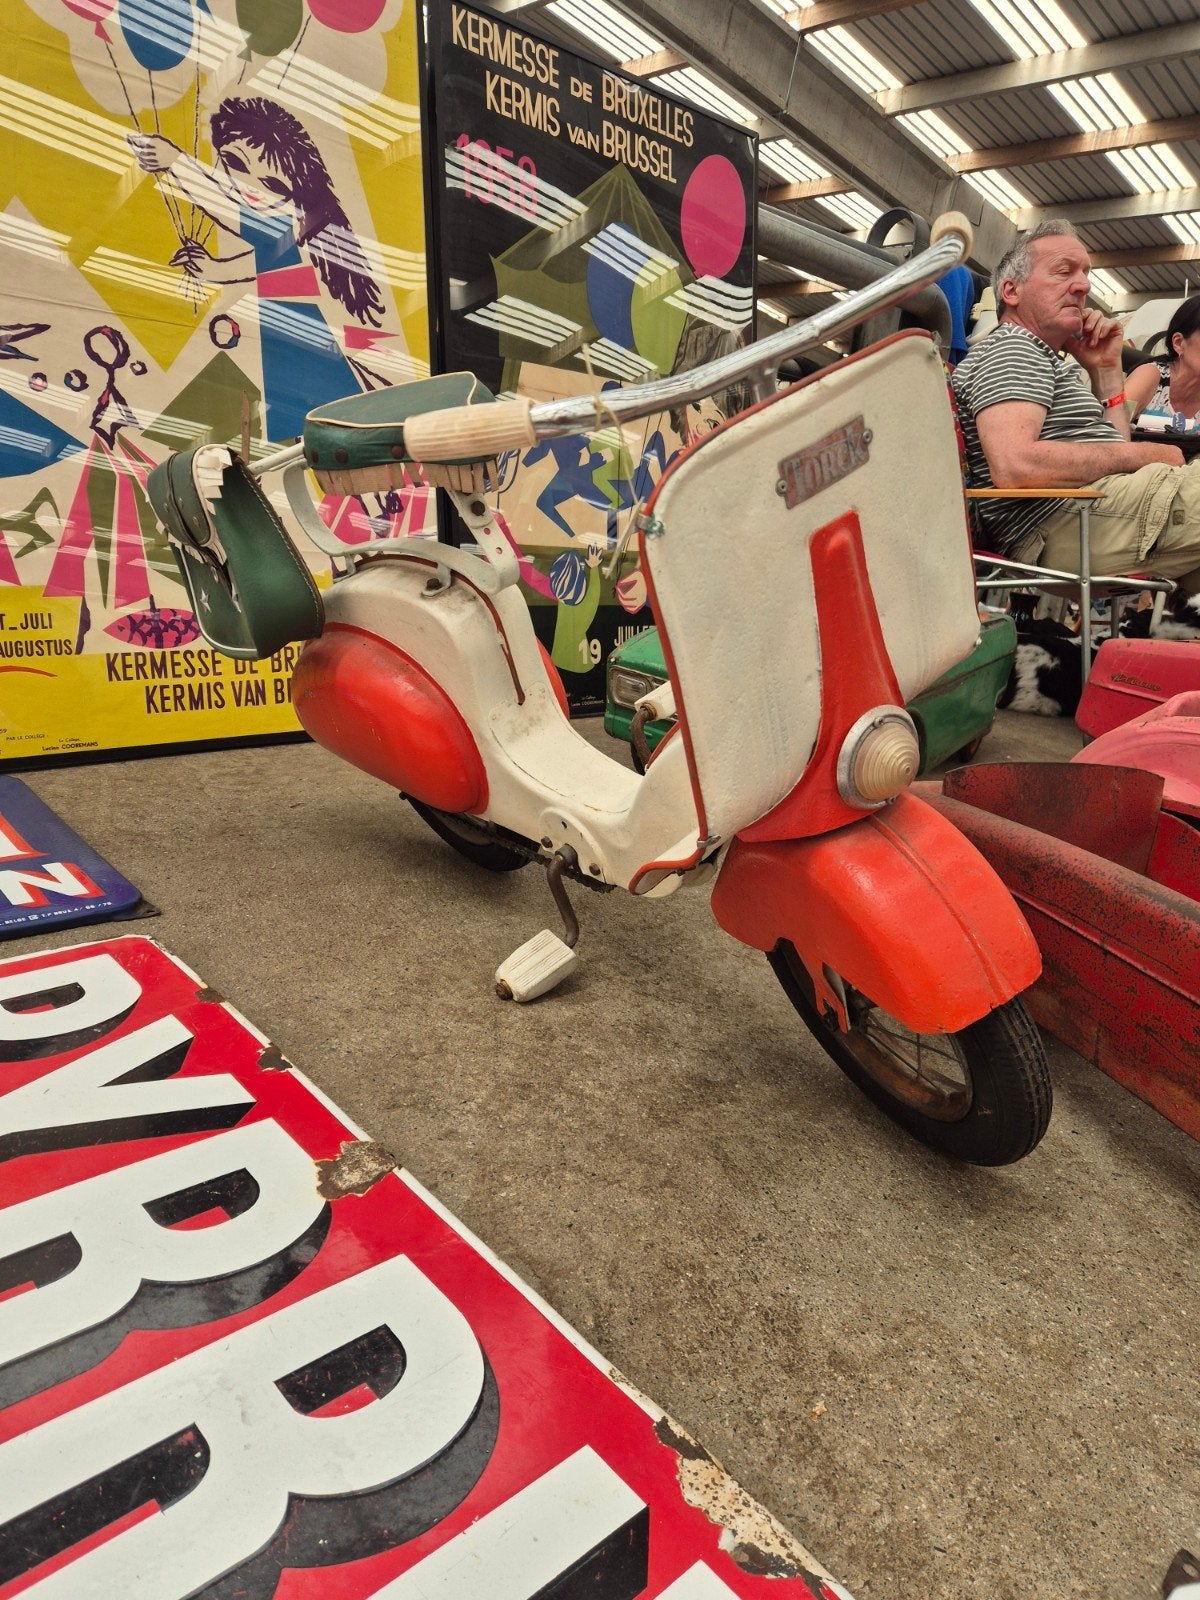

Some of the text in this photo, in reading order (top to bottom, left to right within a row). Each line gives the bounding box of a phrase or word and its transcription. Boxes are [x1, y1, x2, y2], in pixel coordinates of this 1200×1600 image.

[451, 5, 694, 148] KERMESSE DE BRUXELLES
[485, 70, 677, 184] KERMIS VAN BRUSSEL
[456, 133, 538, 217] 1958
[106, 649, 223, 682] KERMESSE
[271, 645, 301, 673] BR
[578, 638, 602, 665] 19
[145, 681, 226, 714] KERMIS
[230, 679, 267, 708] VAN
